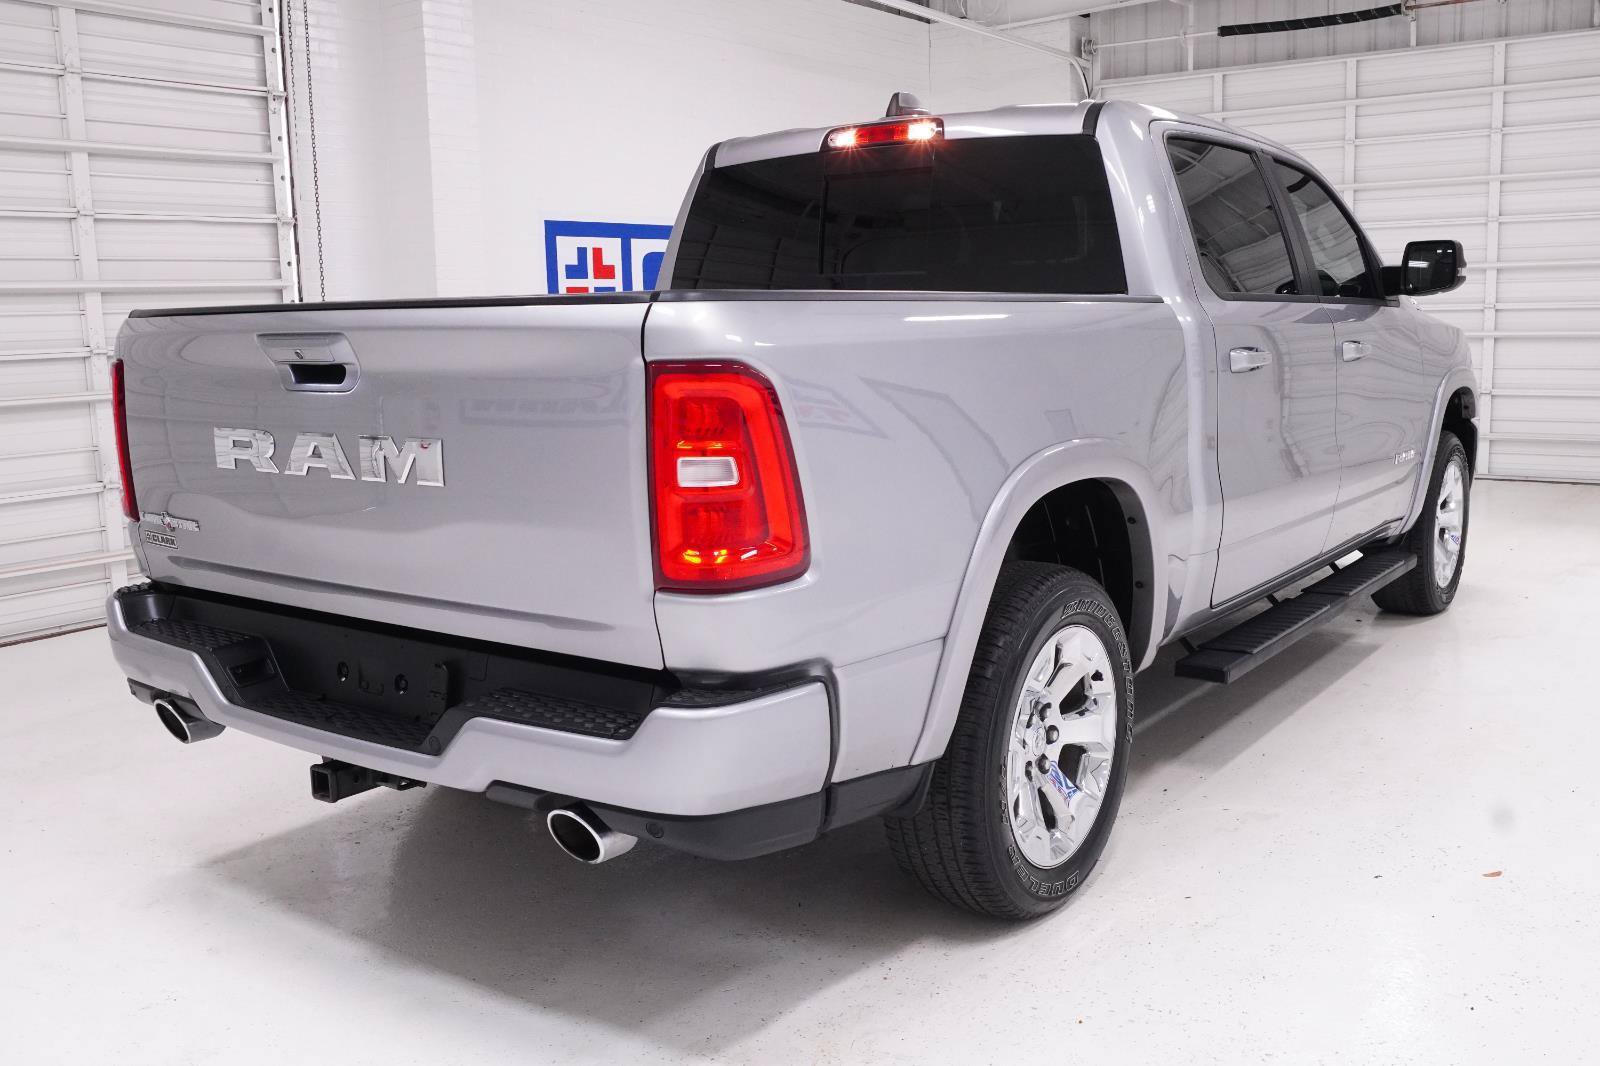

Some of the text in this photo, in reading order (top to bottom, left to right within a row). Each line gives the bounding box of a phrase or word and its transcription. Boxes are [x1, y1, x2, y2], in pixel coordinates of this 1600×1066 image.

[213, 427, 445, 487] RAM
[152, 533, 177, 547] CLARK
[1007, 845, 1080, 898] DUELER
